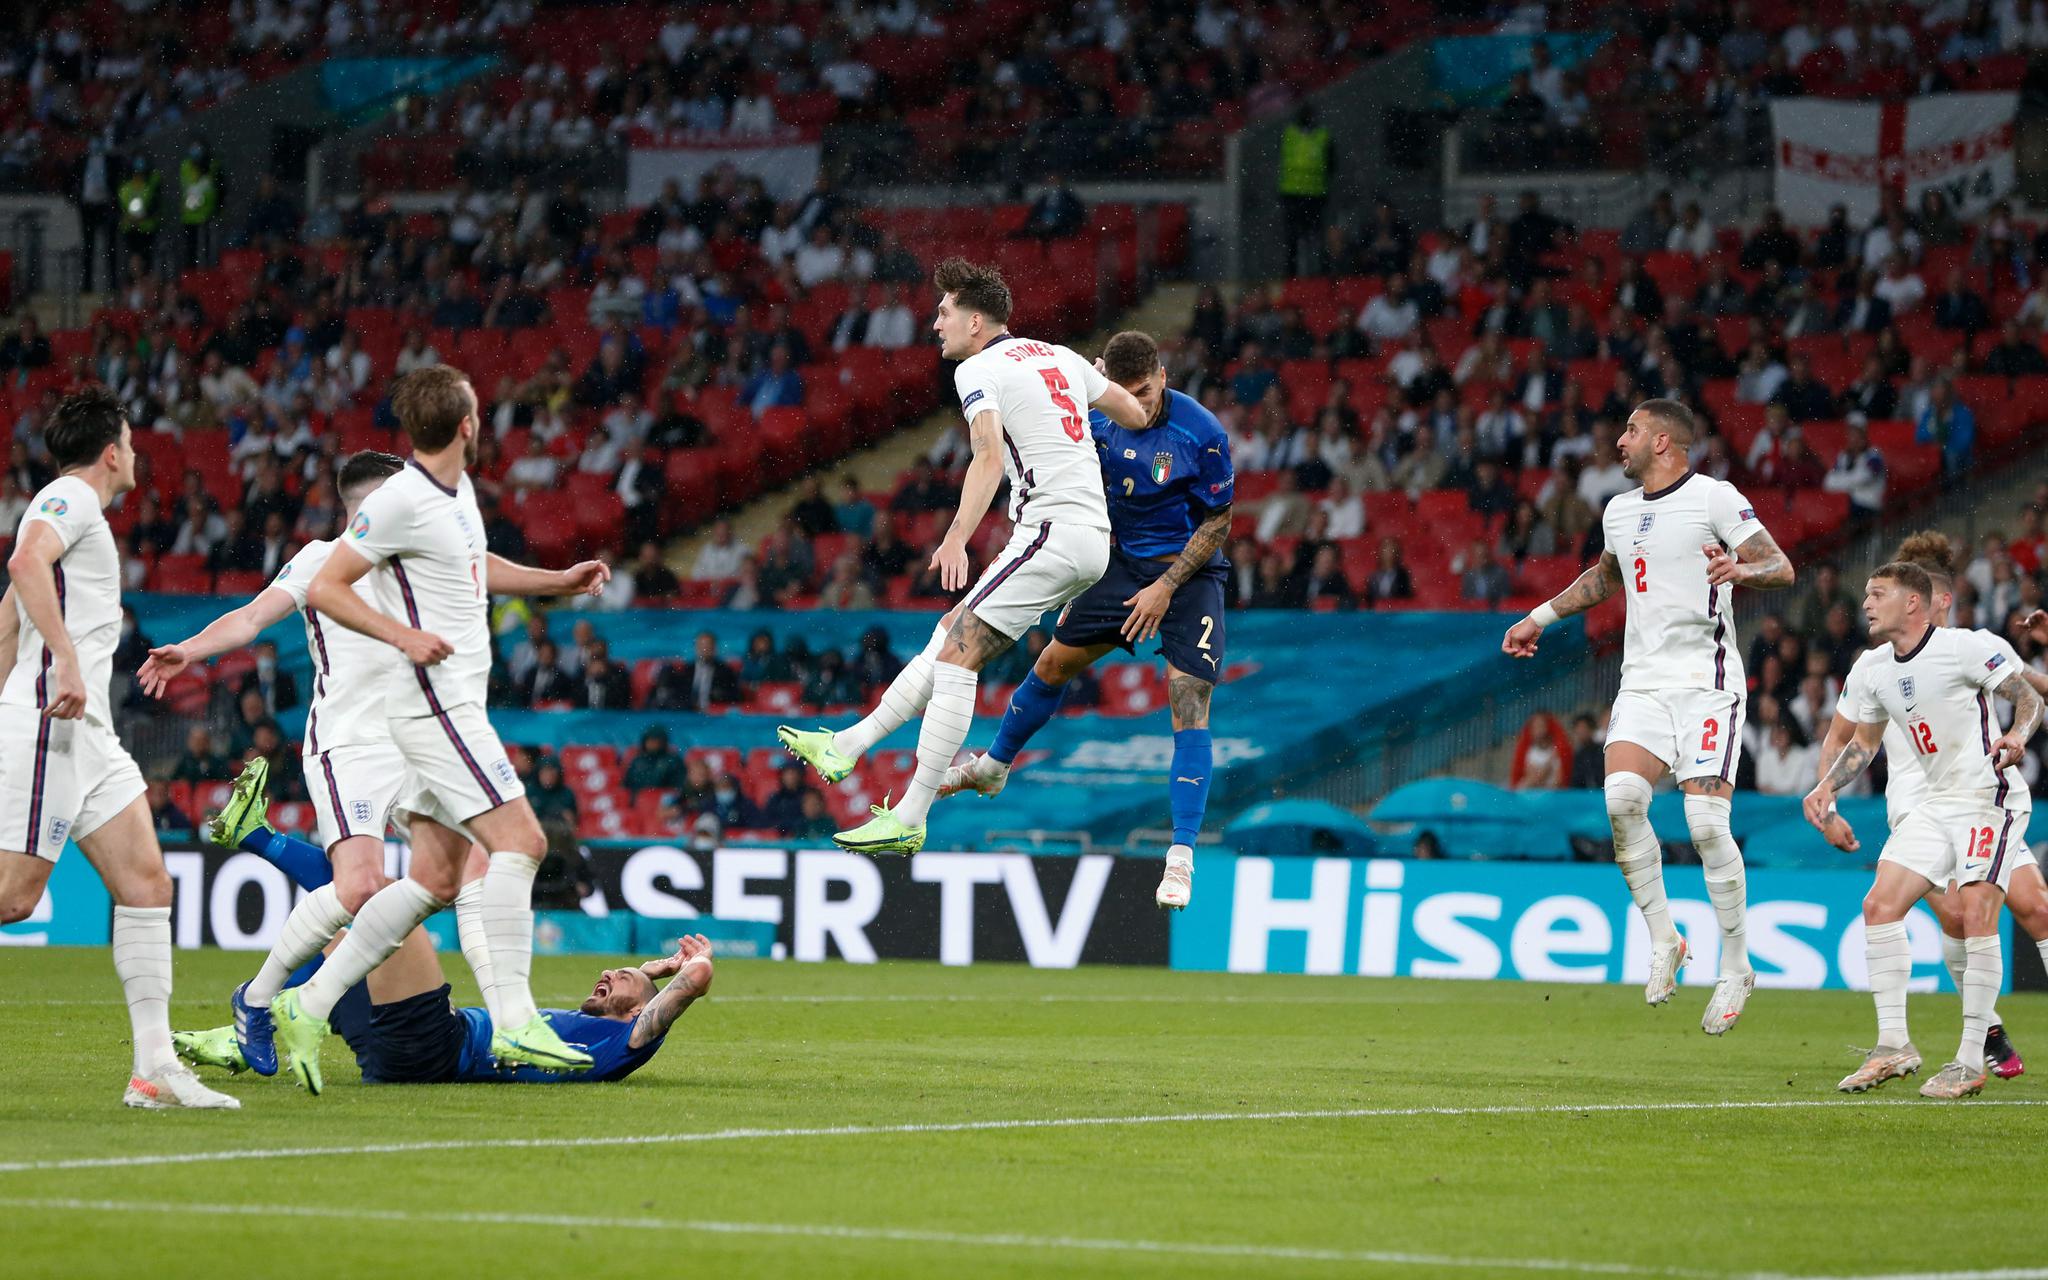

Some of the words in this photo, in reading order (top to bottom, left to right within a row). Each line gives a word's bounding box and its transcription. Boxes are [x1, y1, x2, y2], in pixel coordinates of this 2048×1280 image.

[1005, 342, 1055, 362] STONES
[1038, 367, 1084, 443] 5
[1634, 557, 1648, 593] 2
[1197, 616, 1214, 650] 2
[1701, 718, 1719, 752] 2
[1908, 721, 1939, 756] 12
[1967, 826, 1995, 858] 12
[911, 854, 1114, 969] TV
[1227, 857, 1943, 994] Hisense
